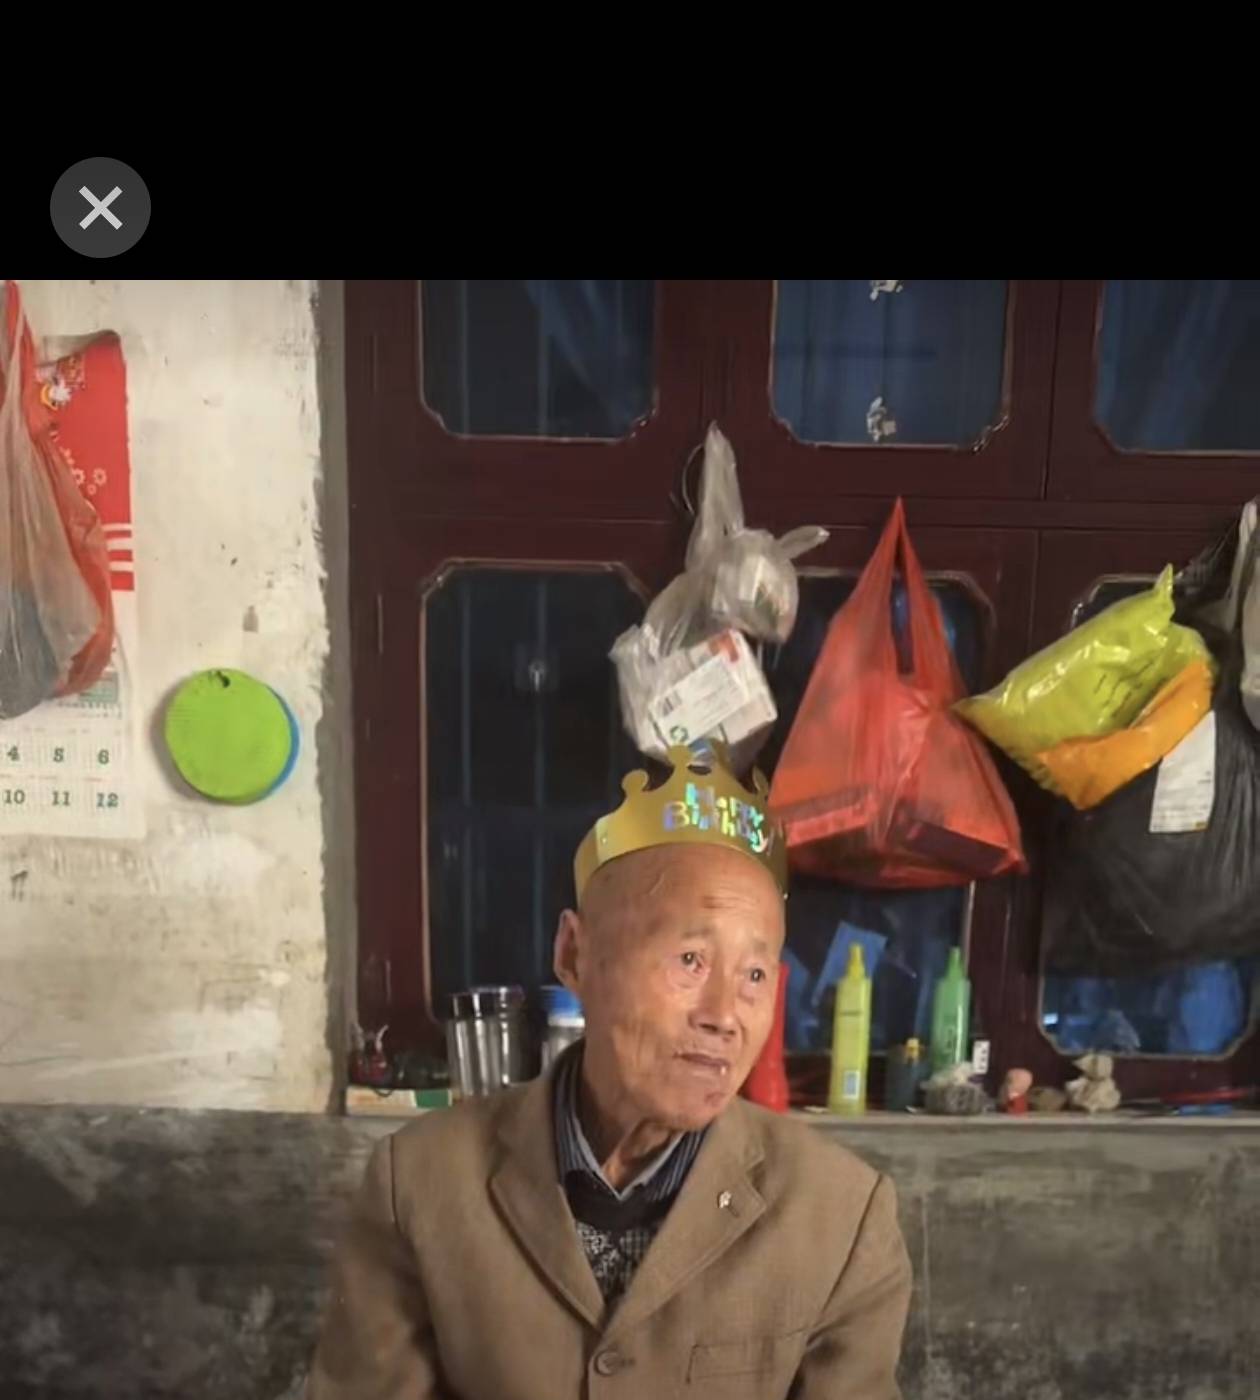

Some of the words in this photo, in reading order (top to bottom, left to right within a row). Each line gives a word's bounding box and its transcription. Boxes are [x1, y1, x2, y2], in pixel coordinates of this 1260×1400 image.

[7, 746, 19, 762] 4
[53, 747, 64, 763] 5
[97, 749, 110, 765] 6
[4, 789, 26, 805] 10
[52, 791, 71, 807] 11
[96, 792, 119, 808] 12
